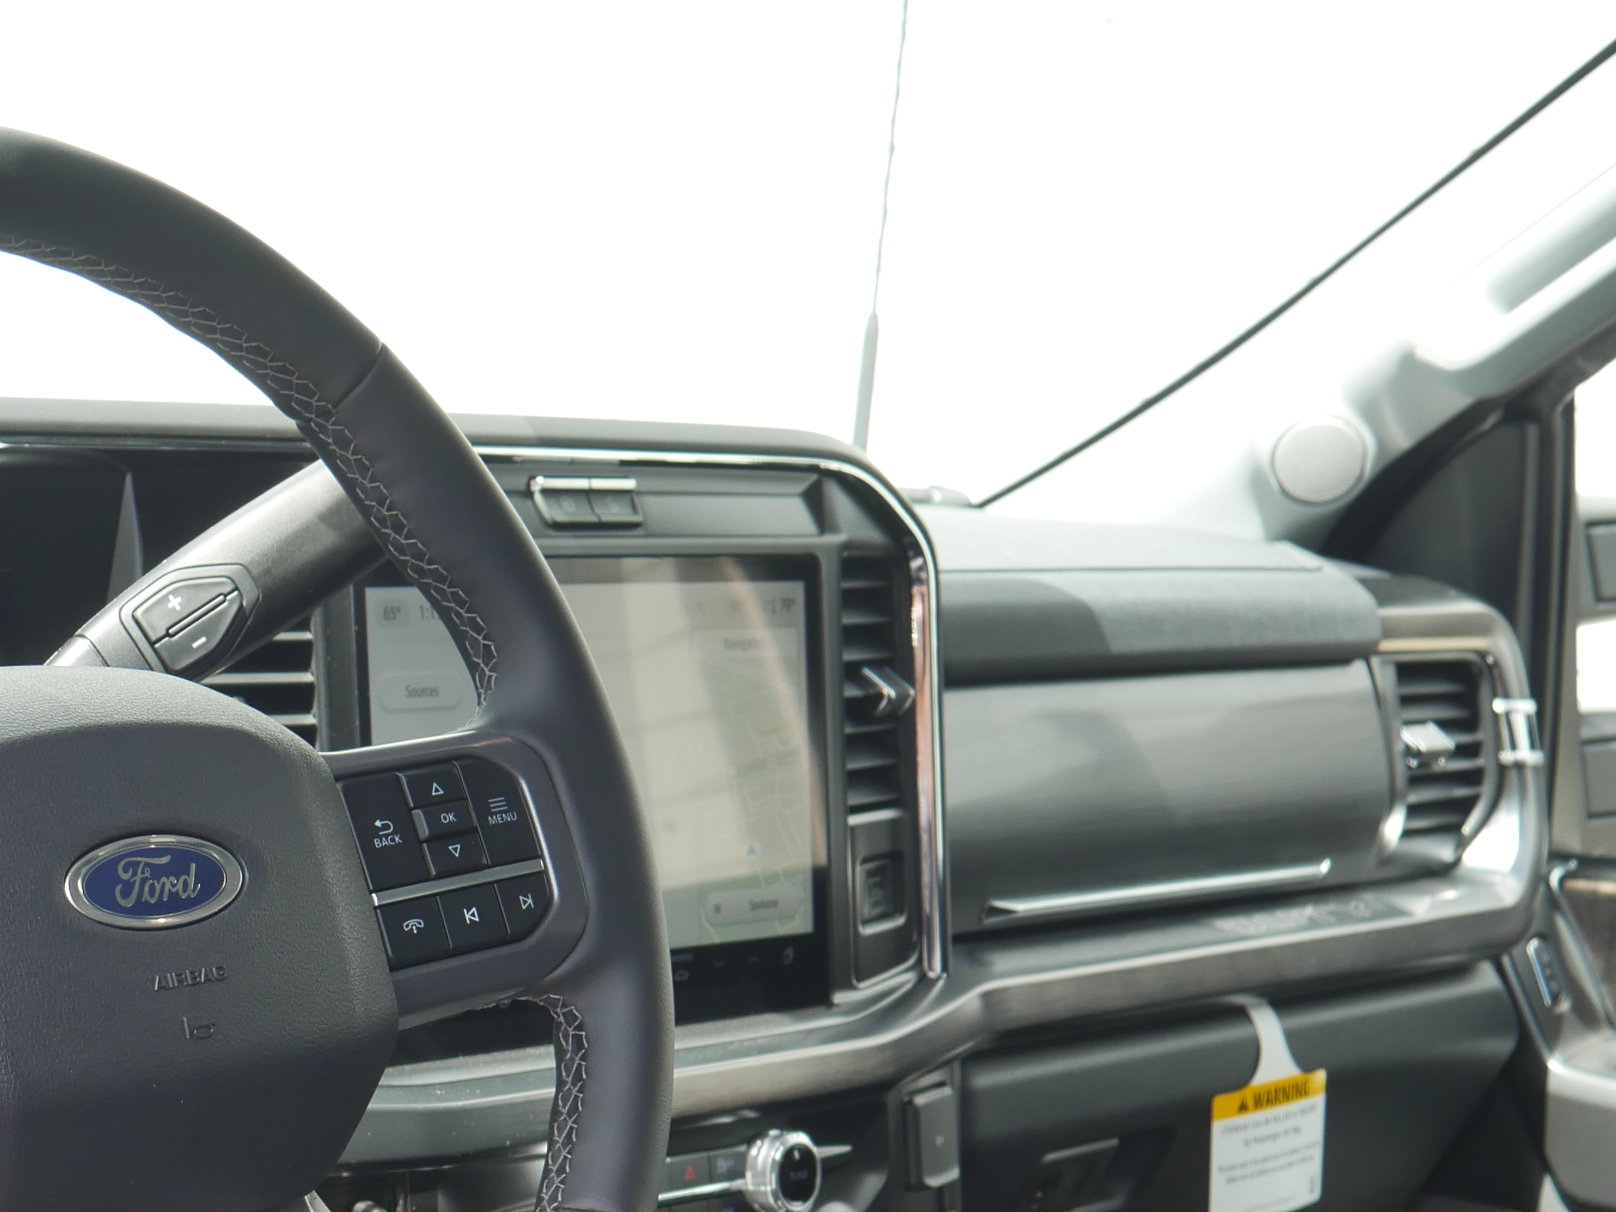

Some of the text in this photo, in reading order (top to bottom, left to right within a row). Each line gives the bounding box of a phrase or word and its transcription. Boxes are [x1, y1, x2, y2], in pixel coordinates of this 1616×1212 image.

[441, 812, 456, 824] OK
[488, 812, 517, 825] MENU
[374, 834, 403, 848] BACK
[115, 855, 201, 908] Ford
[154, 965, 227, 991] AIRBAG
[1253, 1080, 1310, 1112] WARNING
